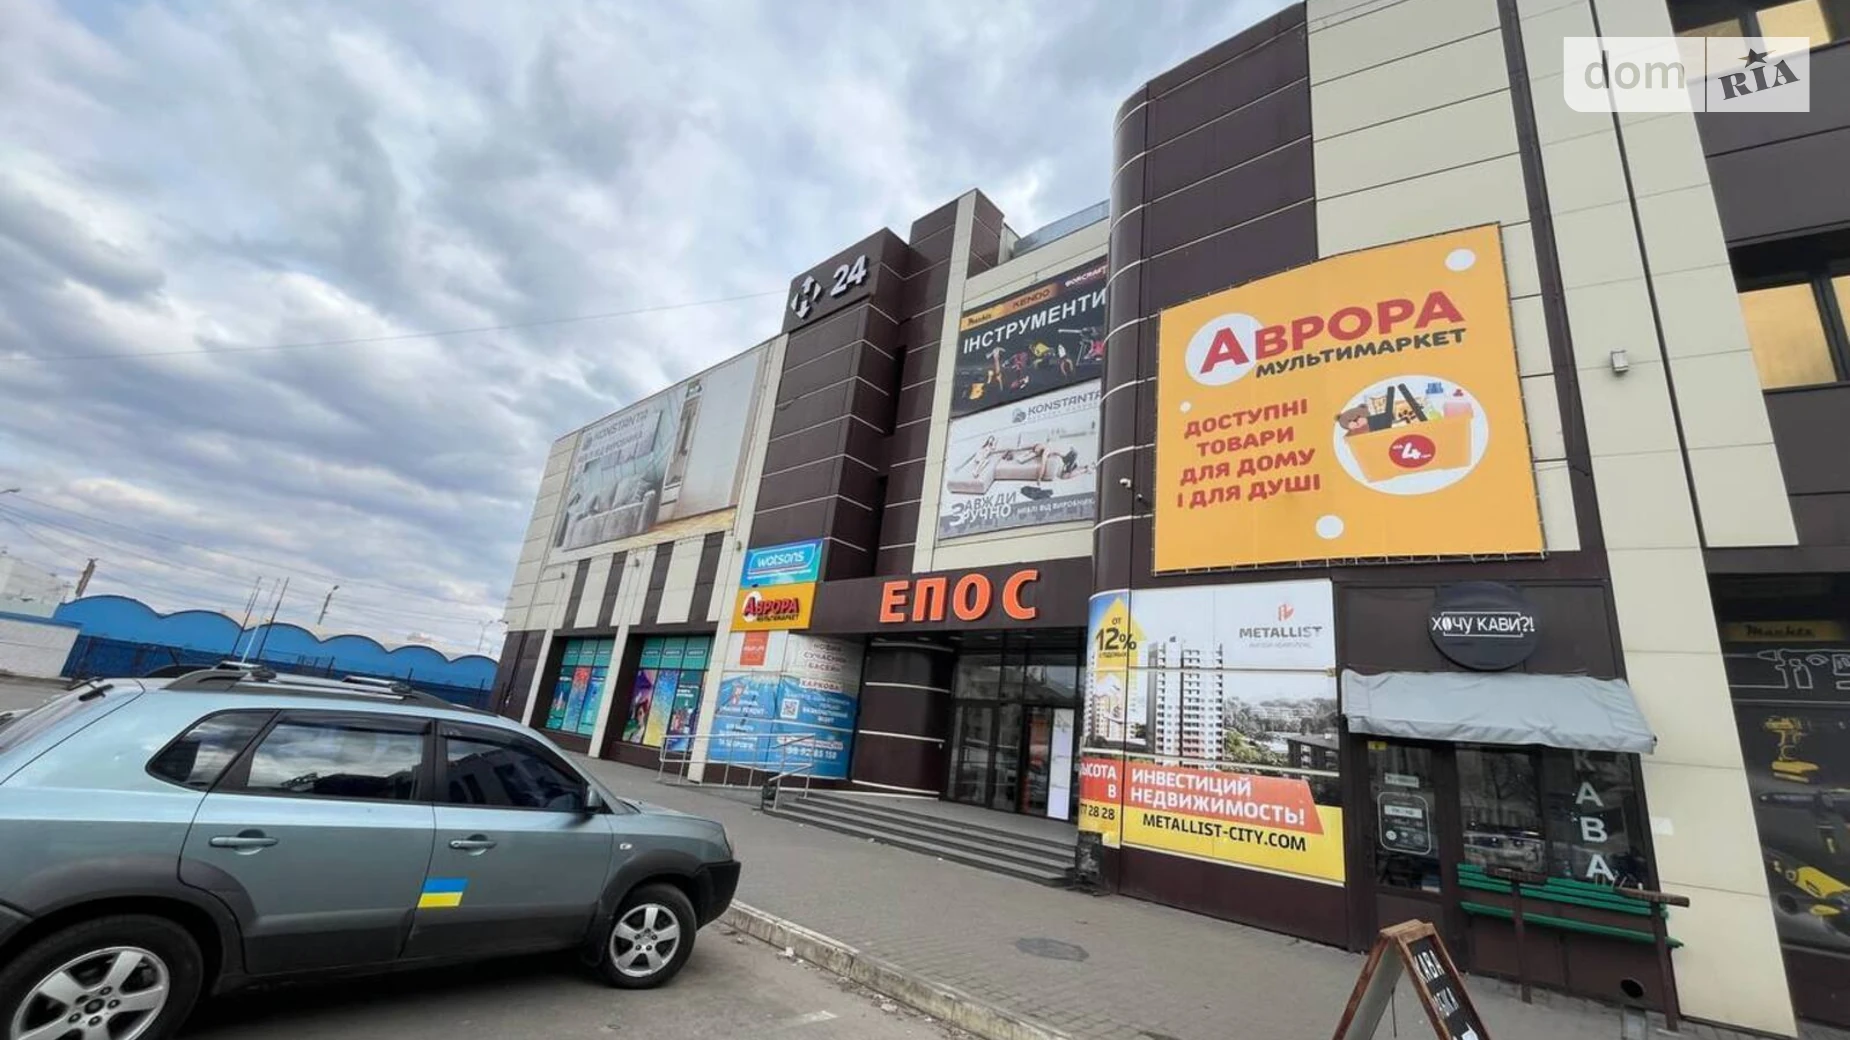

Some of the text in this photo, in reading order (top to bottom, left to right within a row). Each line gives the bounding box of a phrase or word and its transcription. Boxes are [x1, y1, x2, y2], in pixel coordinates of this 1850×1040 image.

[830, 254, 867, 297] 24
[963, 288, 1107, 354] ІНСТРУМЕНТИ
[1199, 289, 1465, 374] АВРОРА
[1255, 327, 1467, 378] МУЛЬТИМАРКЕТ
[1183, 398, 1308, 440] ДОСТУПНІ
[1196, 426, 1295, 457] ТОВАРИ
[1180, 447, 1316, 487] ДЛЯ ДОМУ
[1176, 473, 1321, 510] І ДЛЯ ДУШІ
[757, 550, 805, 568] watsons
[879, 569, 1040, 623] ЕПОС
[1096, 627, 1138, 651] 12%
[1239, 626, 1323, 638] METALLIST
[1431, 616, 1536, 635] ХОЧУ КАВИ?!
[1131, 768, 1251, 797] ИНВЕСТИЦИЙ
[1108, 784, 1305, 826] В НЕДВИЖИМОСТЬ!
[1142, 812, 1307, 852] METALLIST-CITY.COM
